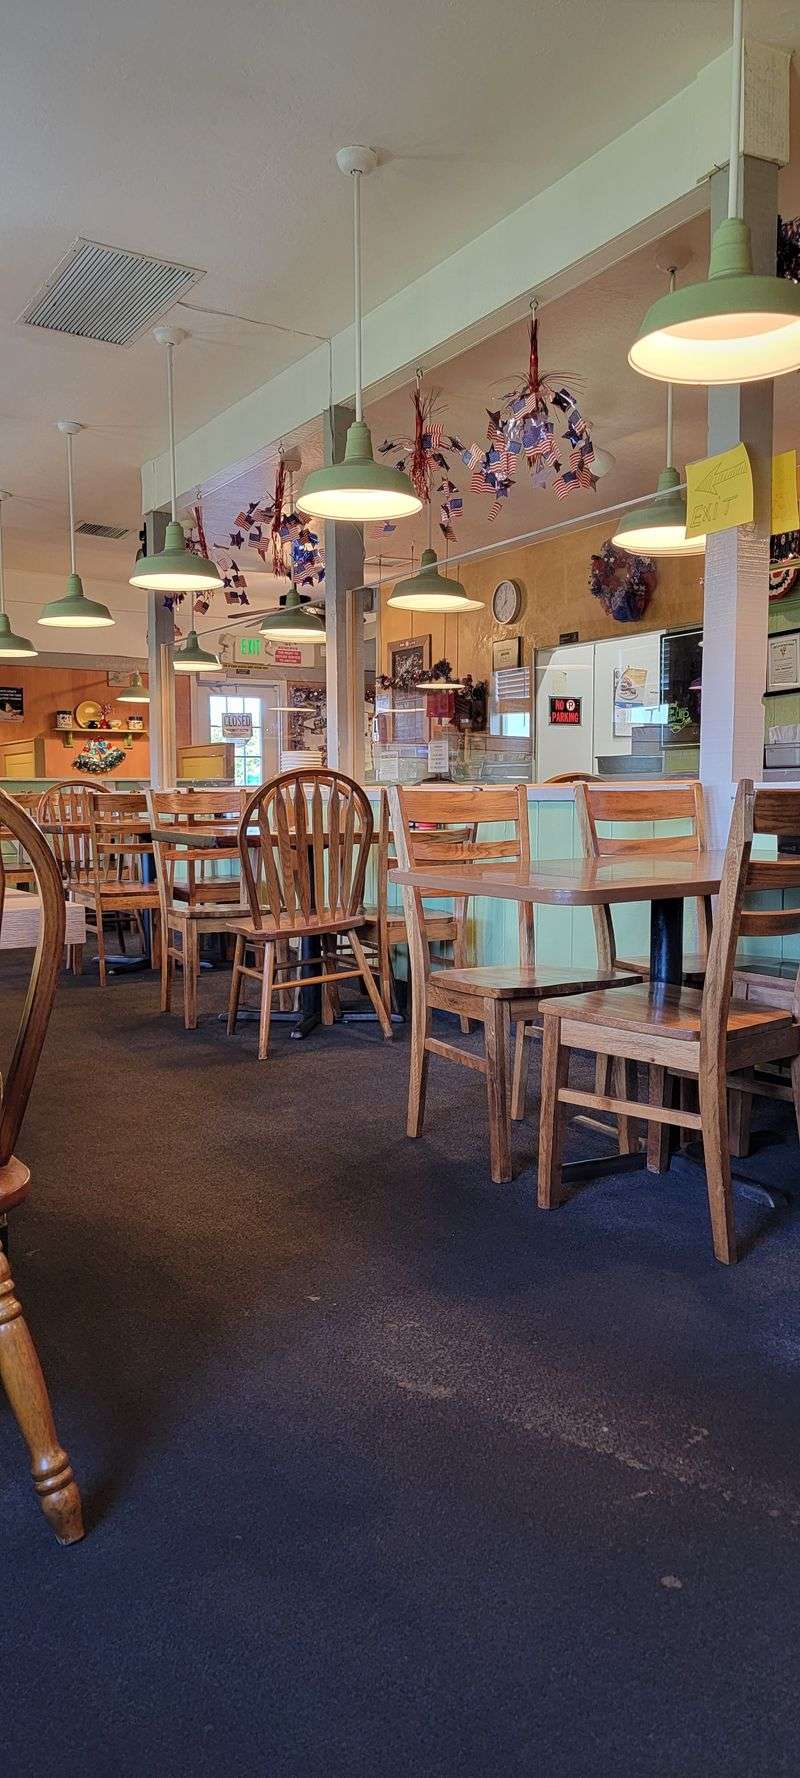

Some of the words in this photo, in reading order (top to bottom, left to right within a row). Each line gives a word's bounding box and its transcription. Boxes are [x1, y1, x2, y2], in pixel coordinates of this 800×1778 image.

[689, 495, 739, 528] EXIT
[241, 639, 260, 655] EXIT
[555, 700, 564, 710] NO
[224, 715, 251, 727] CLOSED
[552, 712, 578, 722] PARKING
